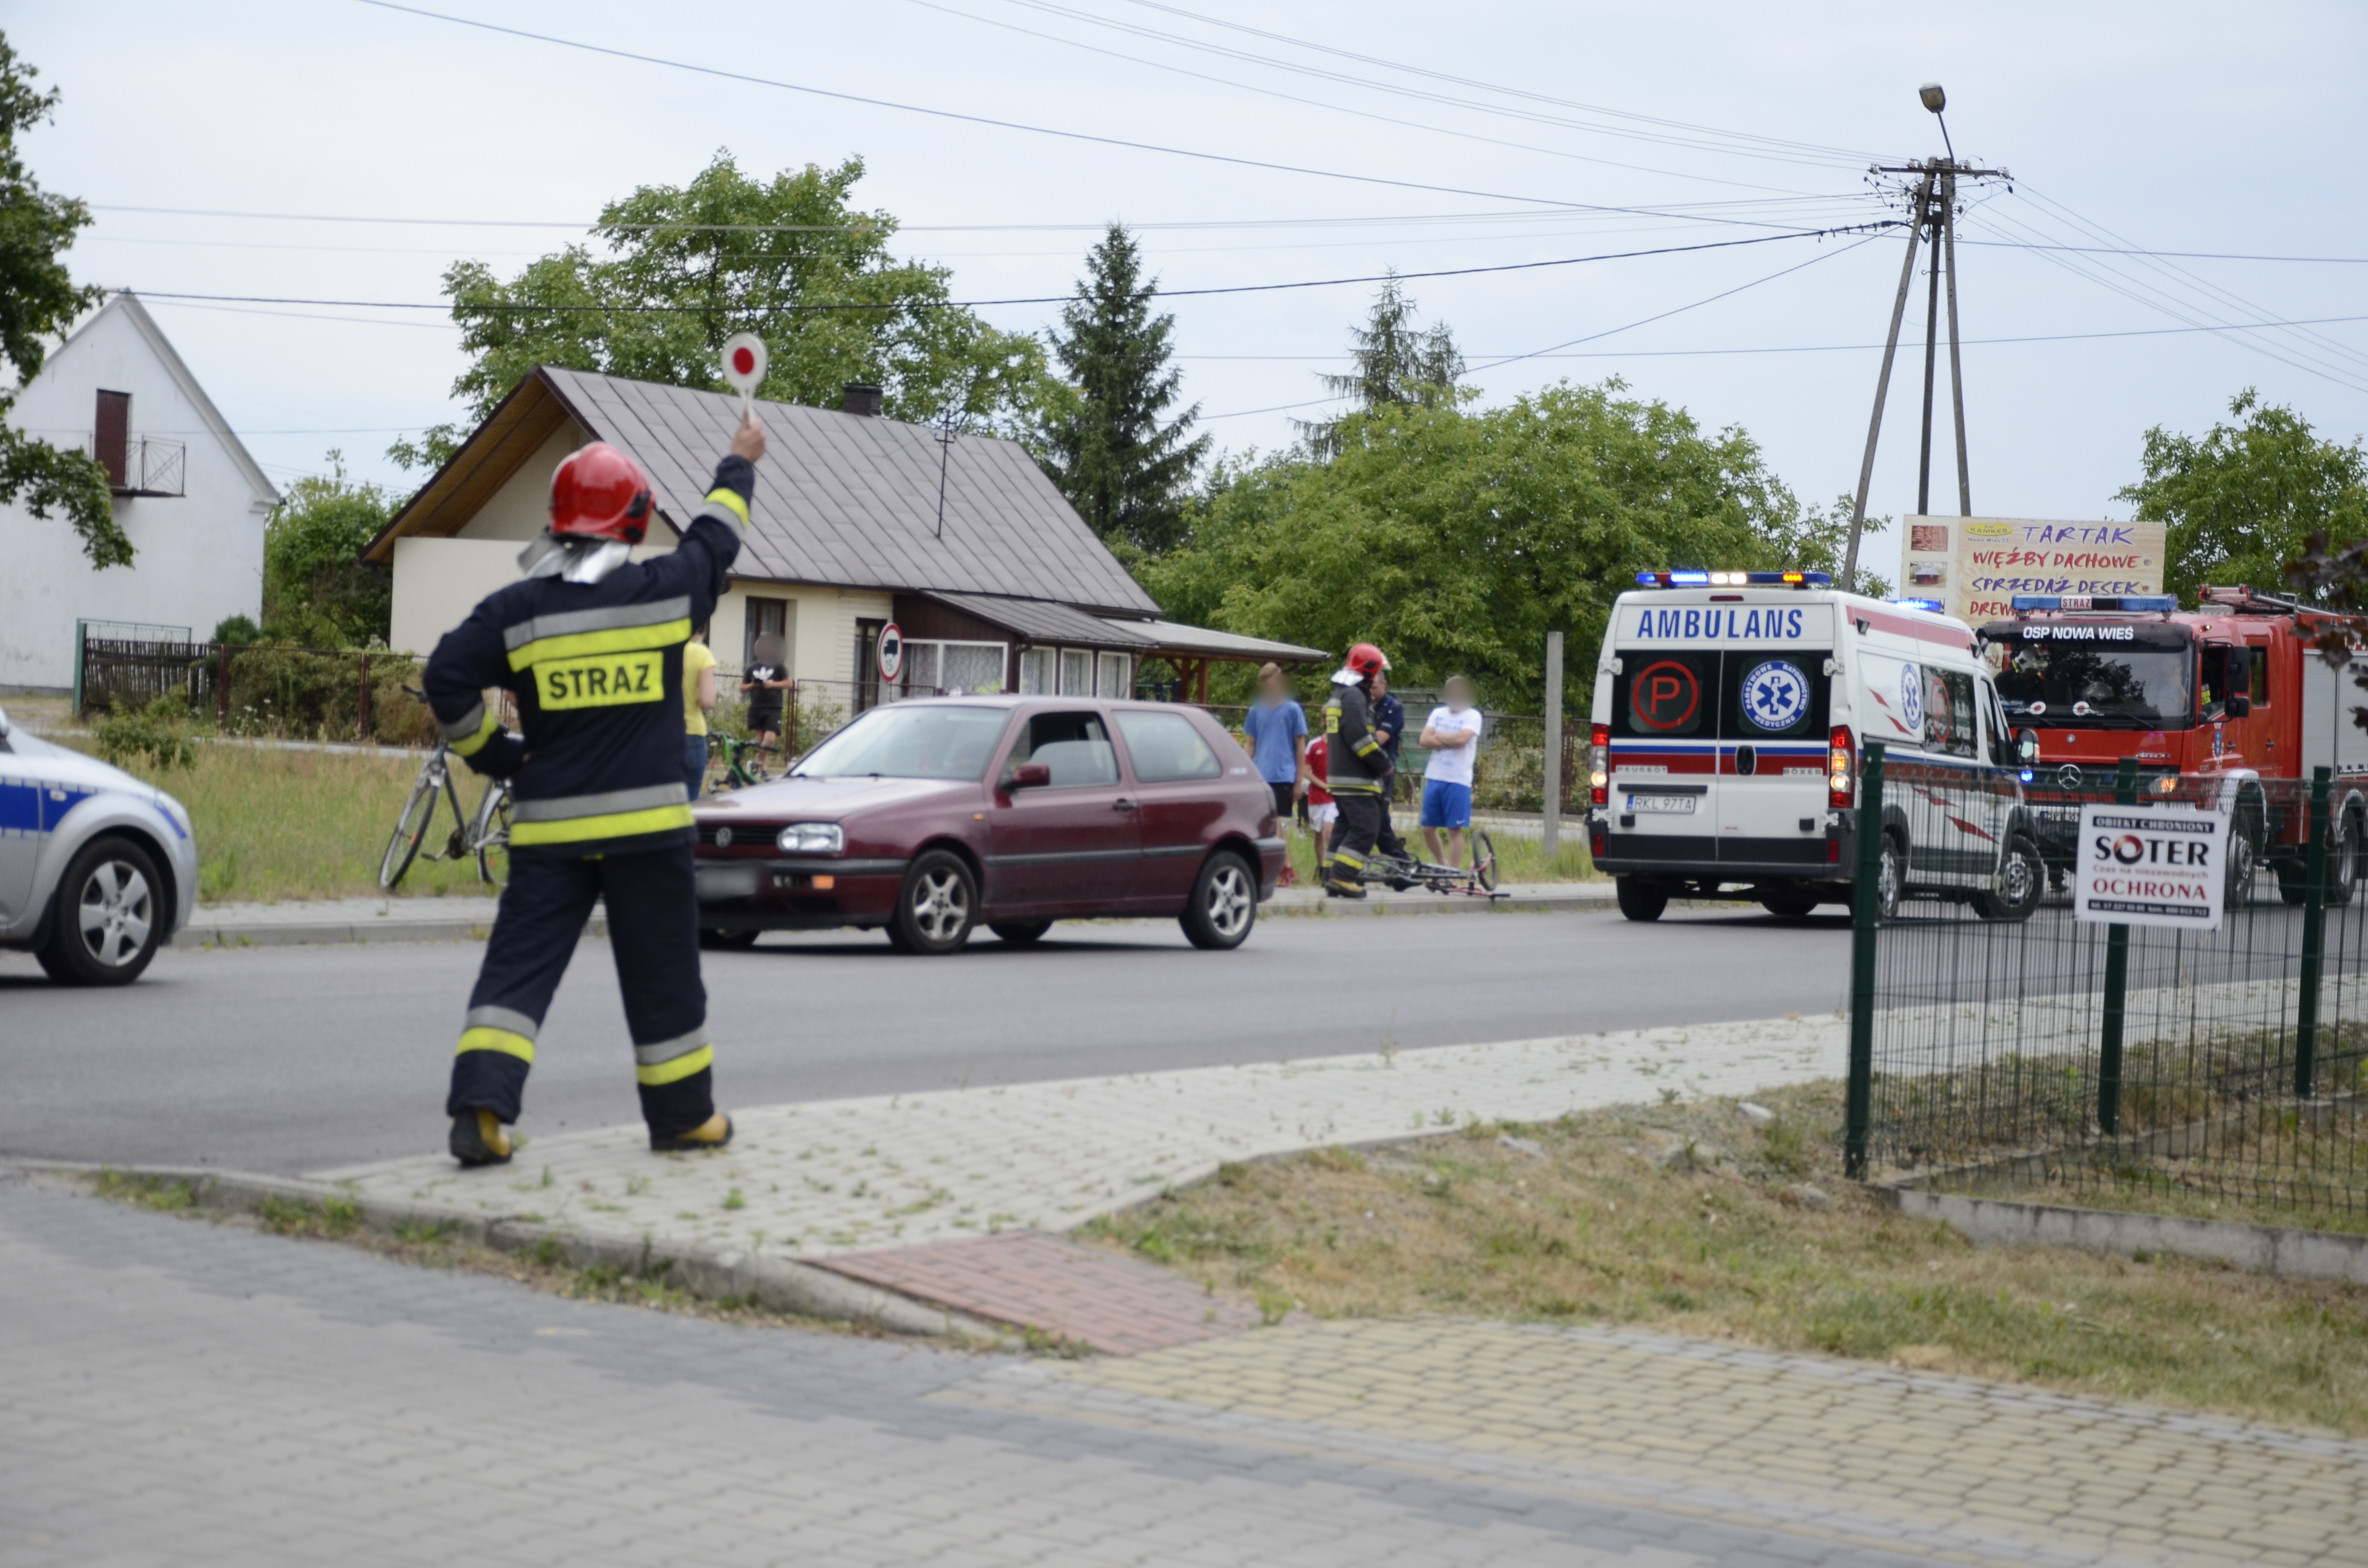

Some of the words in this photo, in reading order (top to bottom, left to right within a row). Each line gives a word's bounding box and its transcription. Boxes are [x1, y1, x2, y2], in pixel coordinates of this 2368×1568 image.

[2021, 525, 2136, 546] TARTAK
[2054, 551, 2142, 570] DACHOWE
[1972, 576, 2074, 594] SPRZEDAŻ
[2078, 580, 2140, 595] DESEK
[1637, 609, 1803, 638] AMBULANS
[2023, 626, 2049, 639] OSP
[2052, 627, 2095, 639] NOWA
[2098, 625, 2134, 640] WIEŚ
[1635, 797, 1658, 809] RKL
[1663, 798, 1692, 810] 97TA
[2139, 820, 2211, 833] CHRONIONY
[2095, 834, 2210, 866] SOTER
[2093, 878, 2207, 900] OCHRONA
